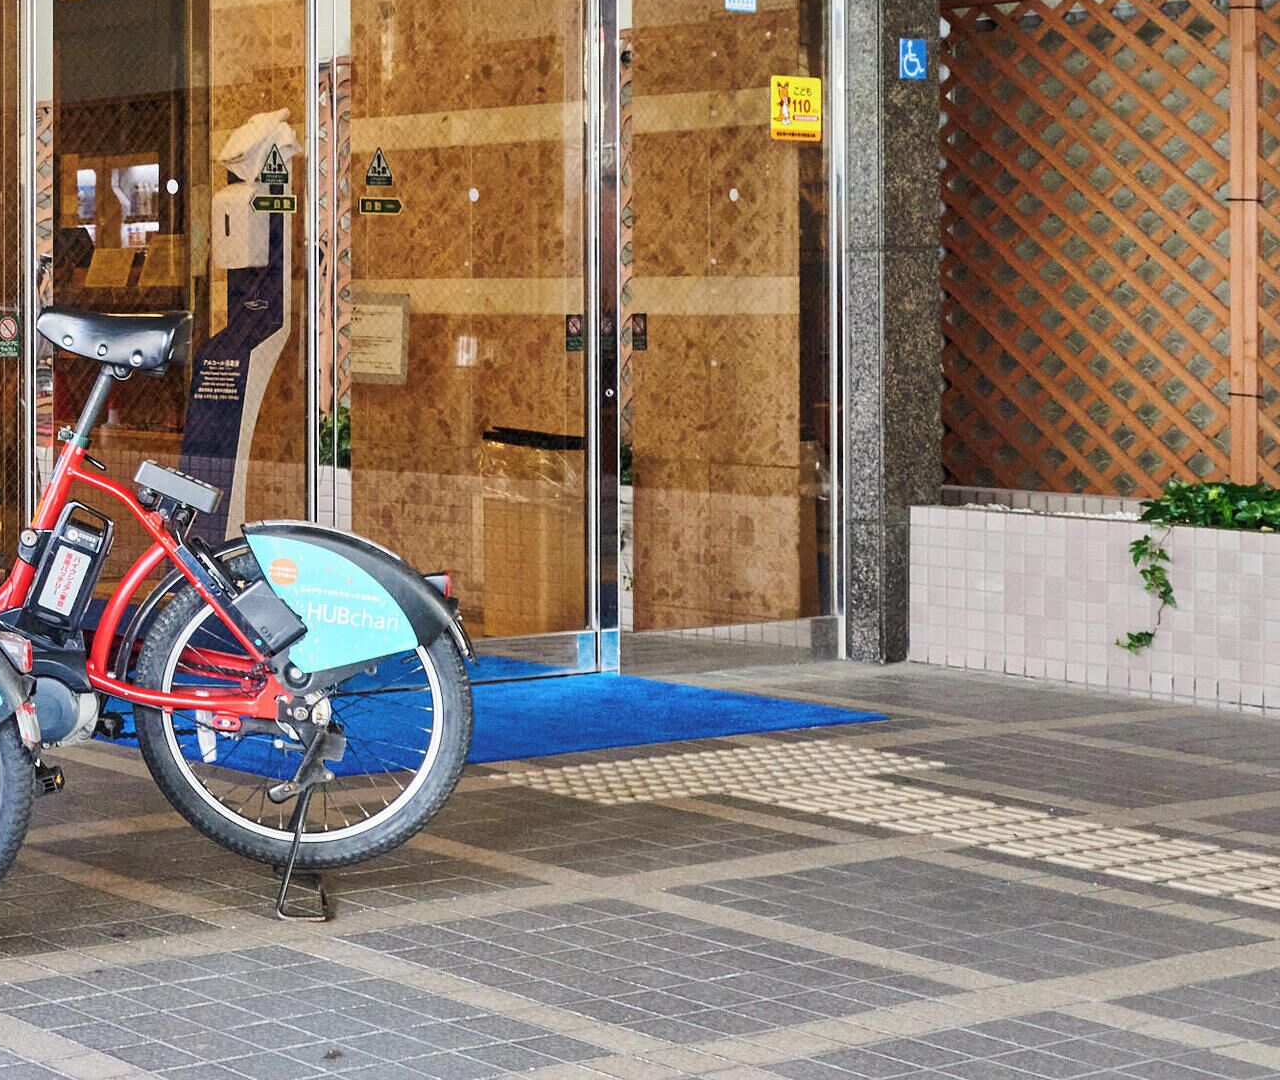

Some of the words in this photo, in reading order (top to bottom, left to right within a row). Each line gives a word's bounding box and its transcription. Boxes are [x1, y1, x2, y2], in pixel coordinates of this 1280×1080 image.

[793, 86, 814, 97] こども
[306, 601, 400, 631] HUBchari
